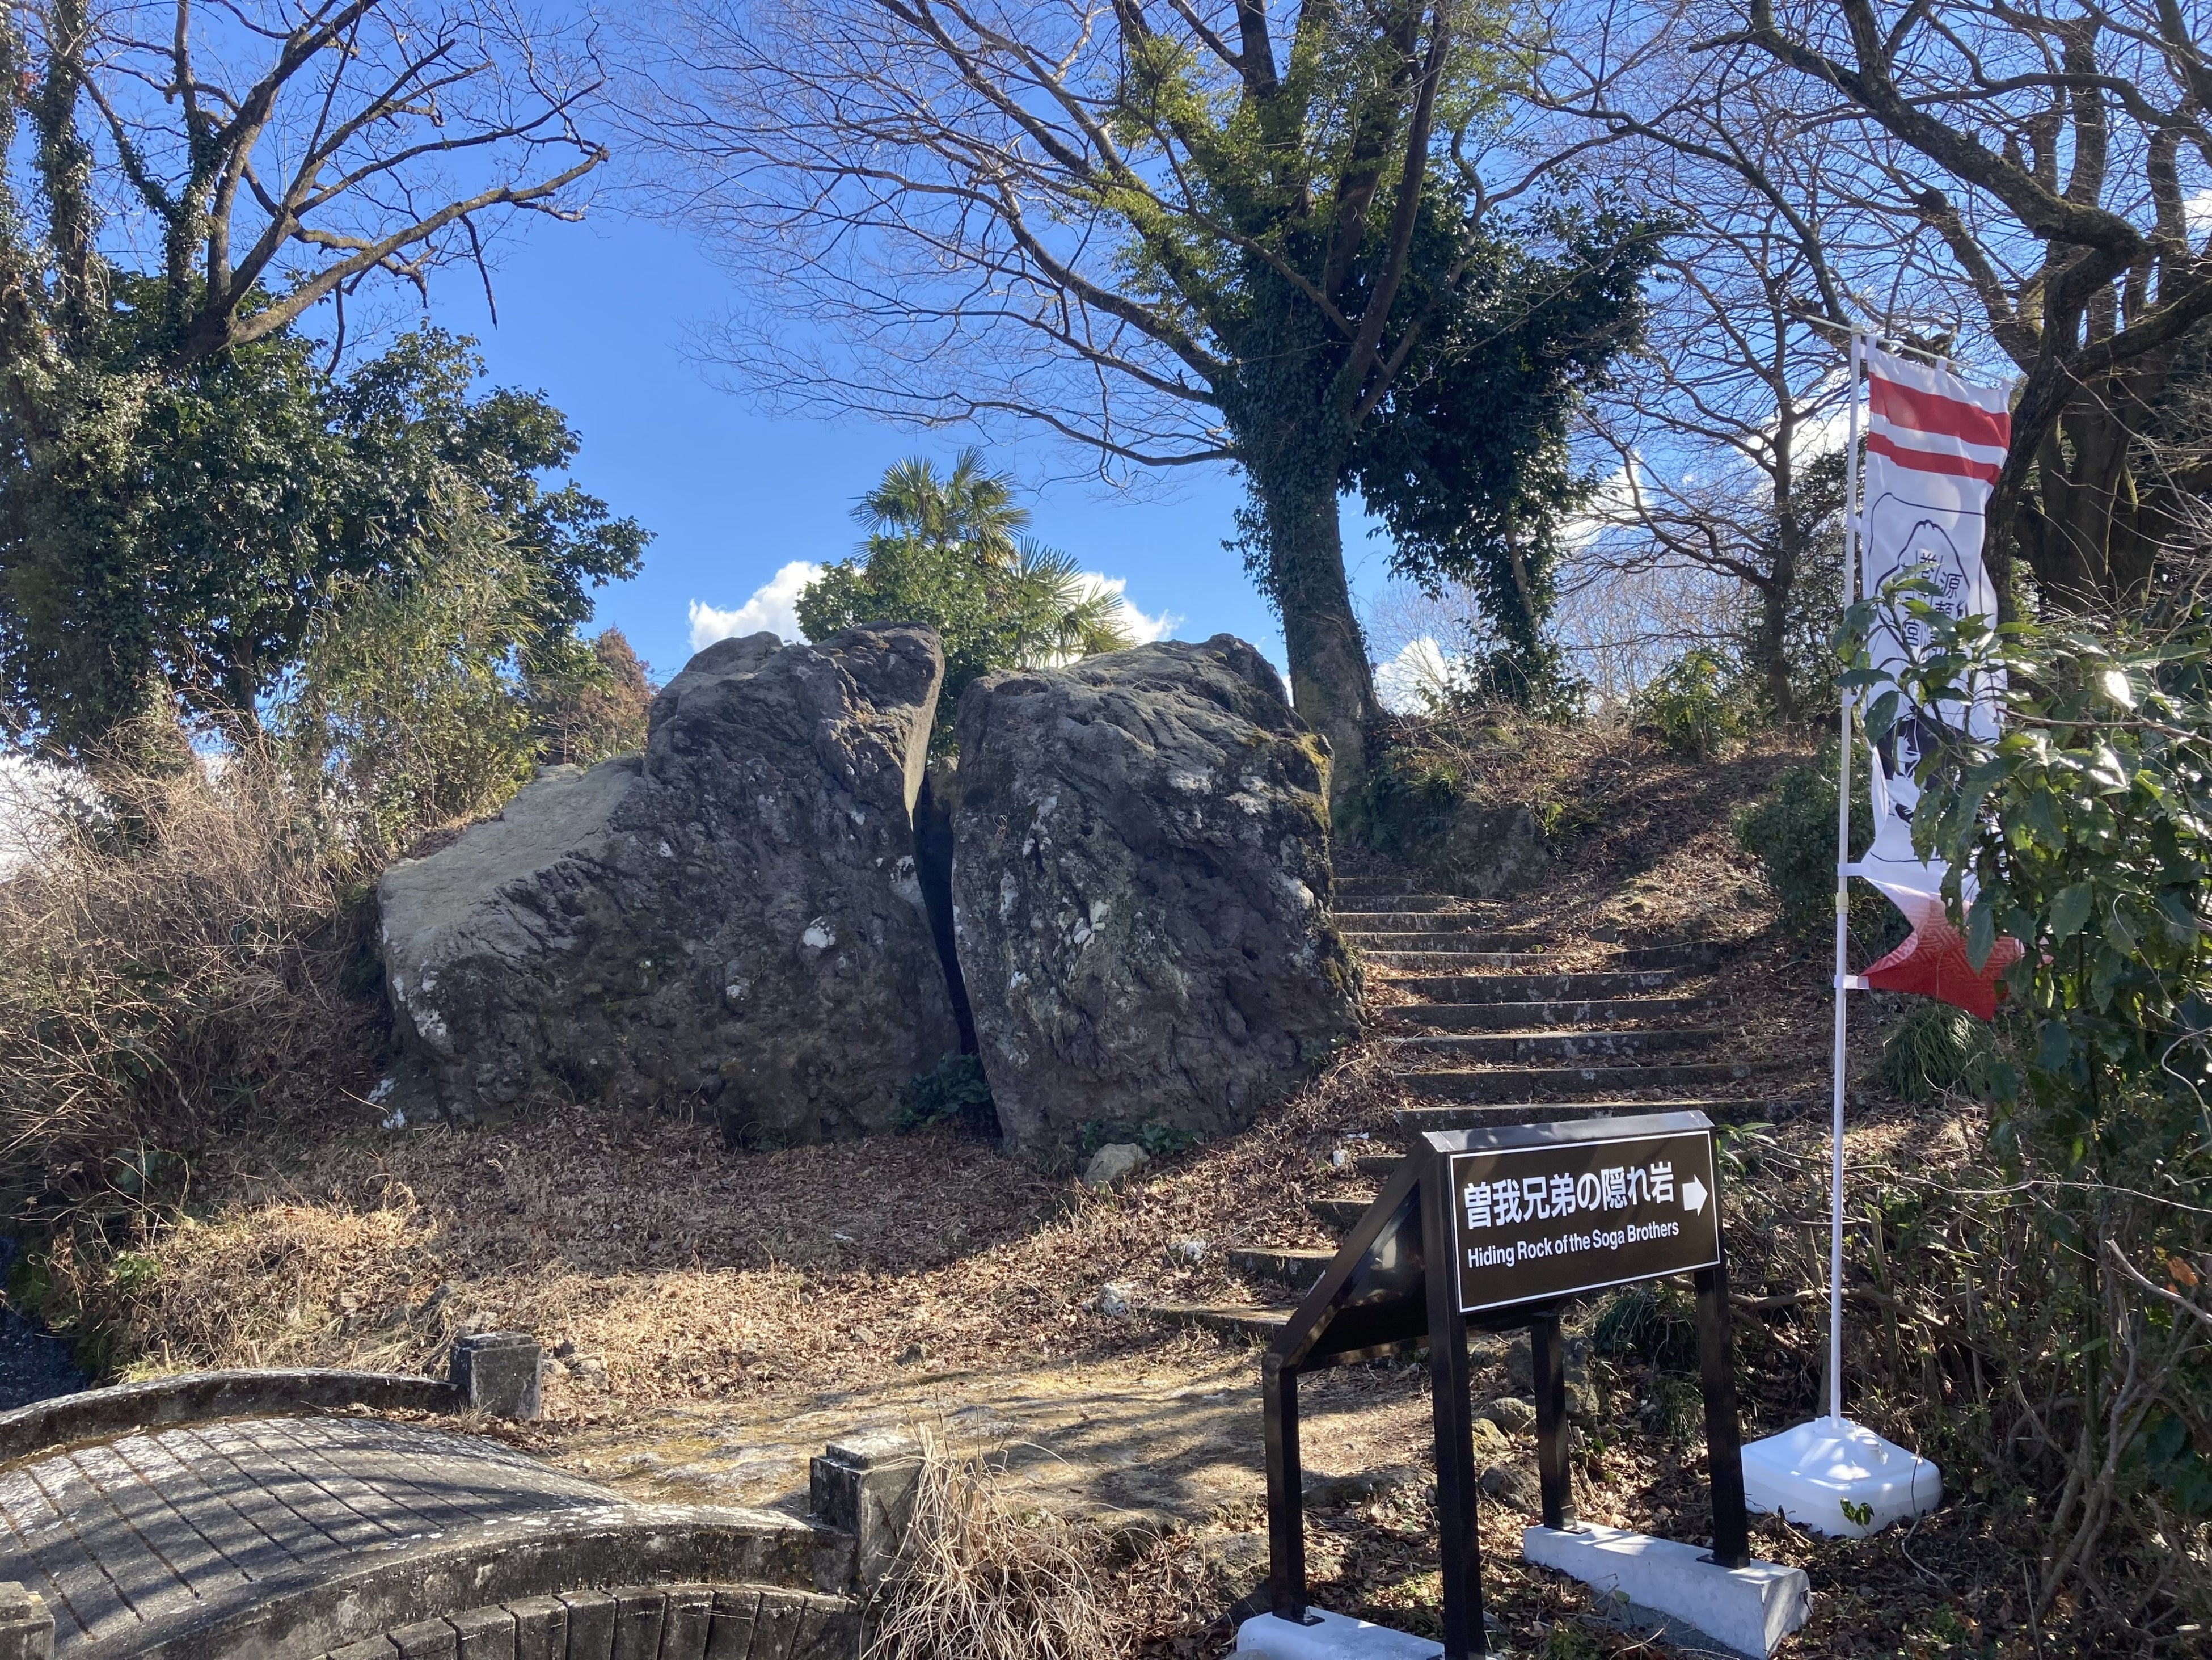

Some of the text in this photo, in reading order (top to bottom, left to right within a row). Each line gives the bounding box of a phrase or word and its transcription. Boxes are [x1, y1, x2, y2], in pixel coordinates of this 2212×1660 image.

[1463, 1161, 1674, 1230] 曽我兄弟の隠れ岩
[1467, 1221, 1679, 1268] Hiding Rock of the Soga Brothers
